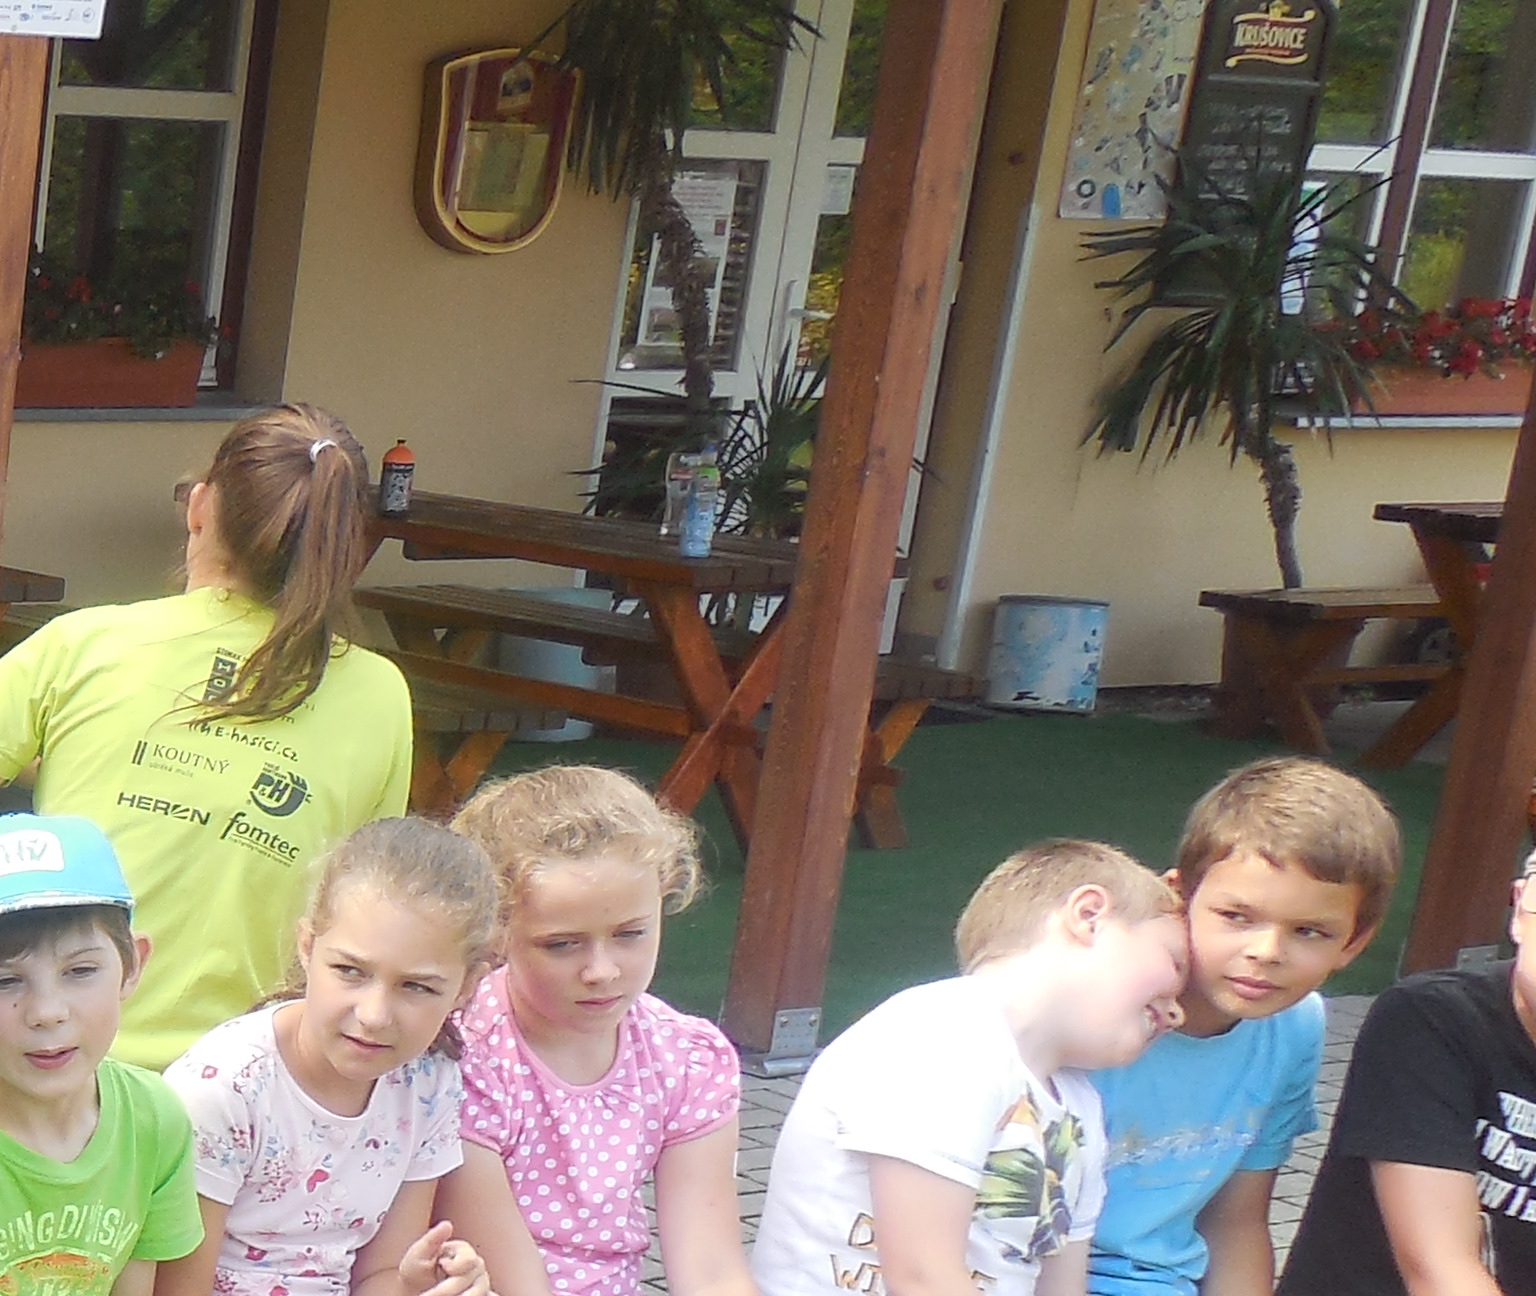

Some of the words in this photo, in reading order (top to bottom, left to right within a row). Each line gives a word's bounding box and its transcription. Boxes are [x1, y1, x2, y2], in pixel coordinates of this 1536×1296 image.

[1233, 21, 1307, 49] KRUŠOVICE
[152, 743, 230, 775] KOUTNÝ
[117, 792, 211, 825] HERON
[220, 811, 300, 859] fomtec
